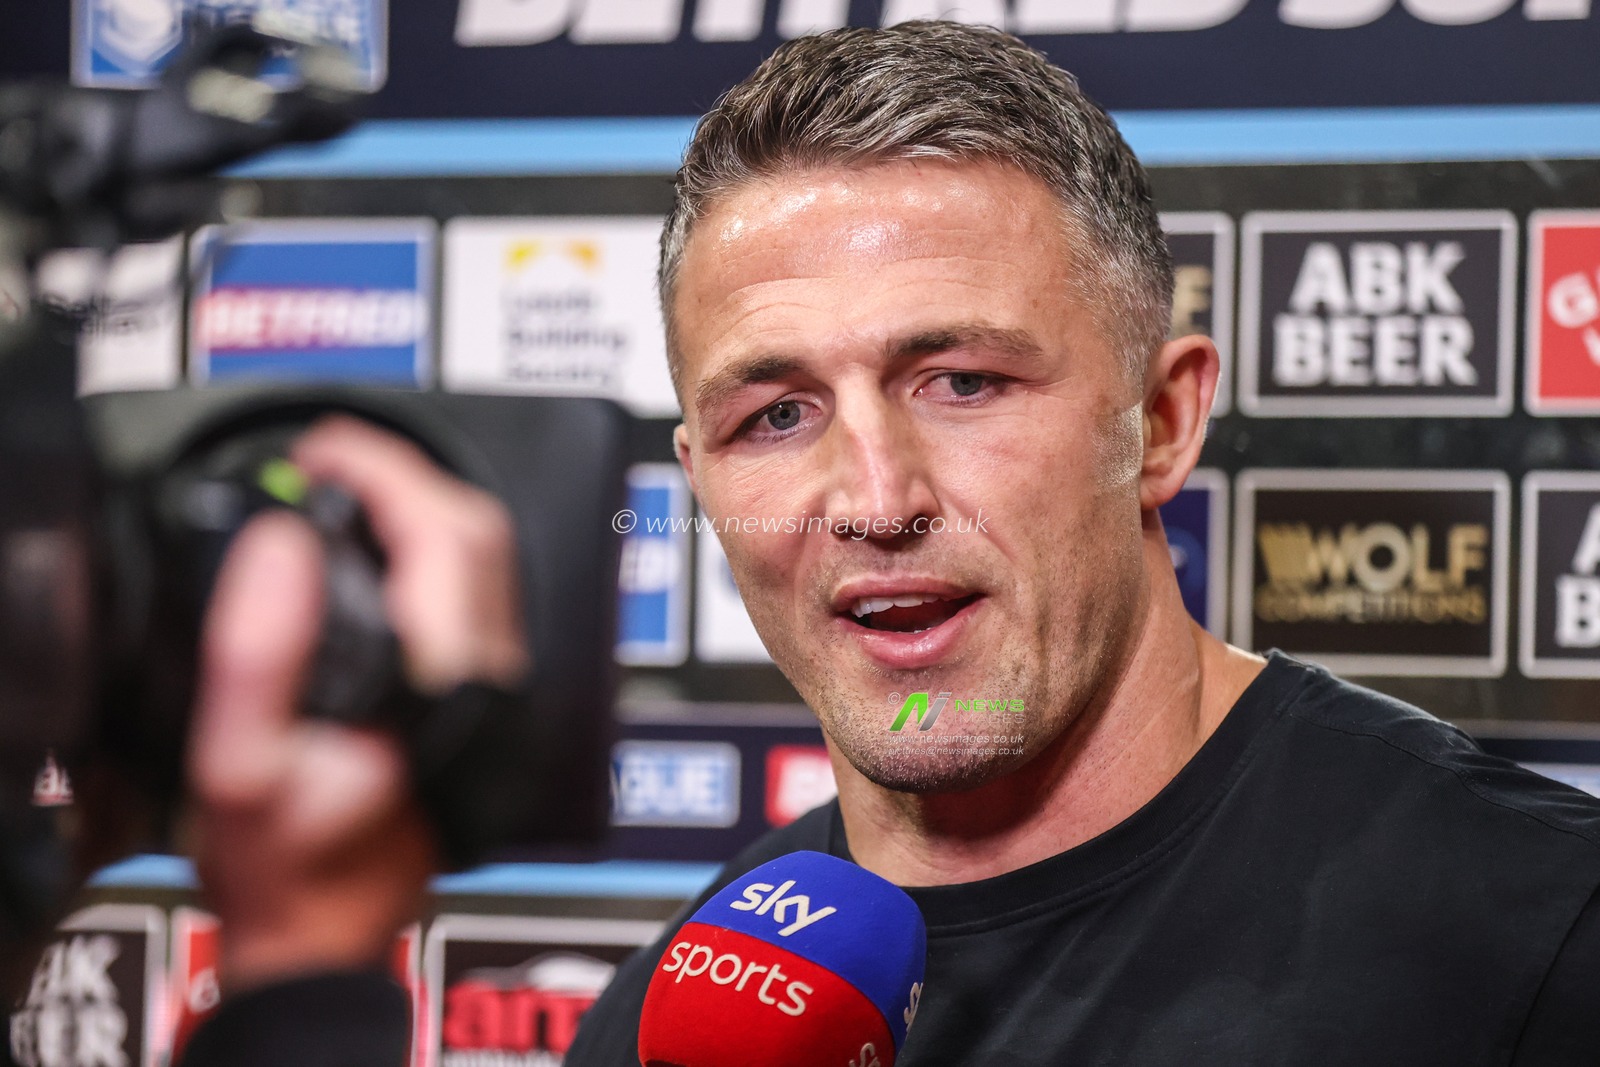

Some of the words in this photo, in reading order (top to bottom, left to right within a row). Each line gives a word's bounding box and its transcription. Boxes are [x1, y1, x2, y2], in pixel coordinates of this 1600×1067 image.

[1290, 242, 1466, 314] ABK
[1273, 314, 1478, 386] BEER
[1258, 523, 1489, 593] WOLF
[729, 880, 837, 937] sky
[661, 941, 813, 1017] sports
